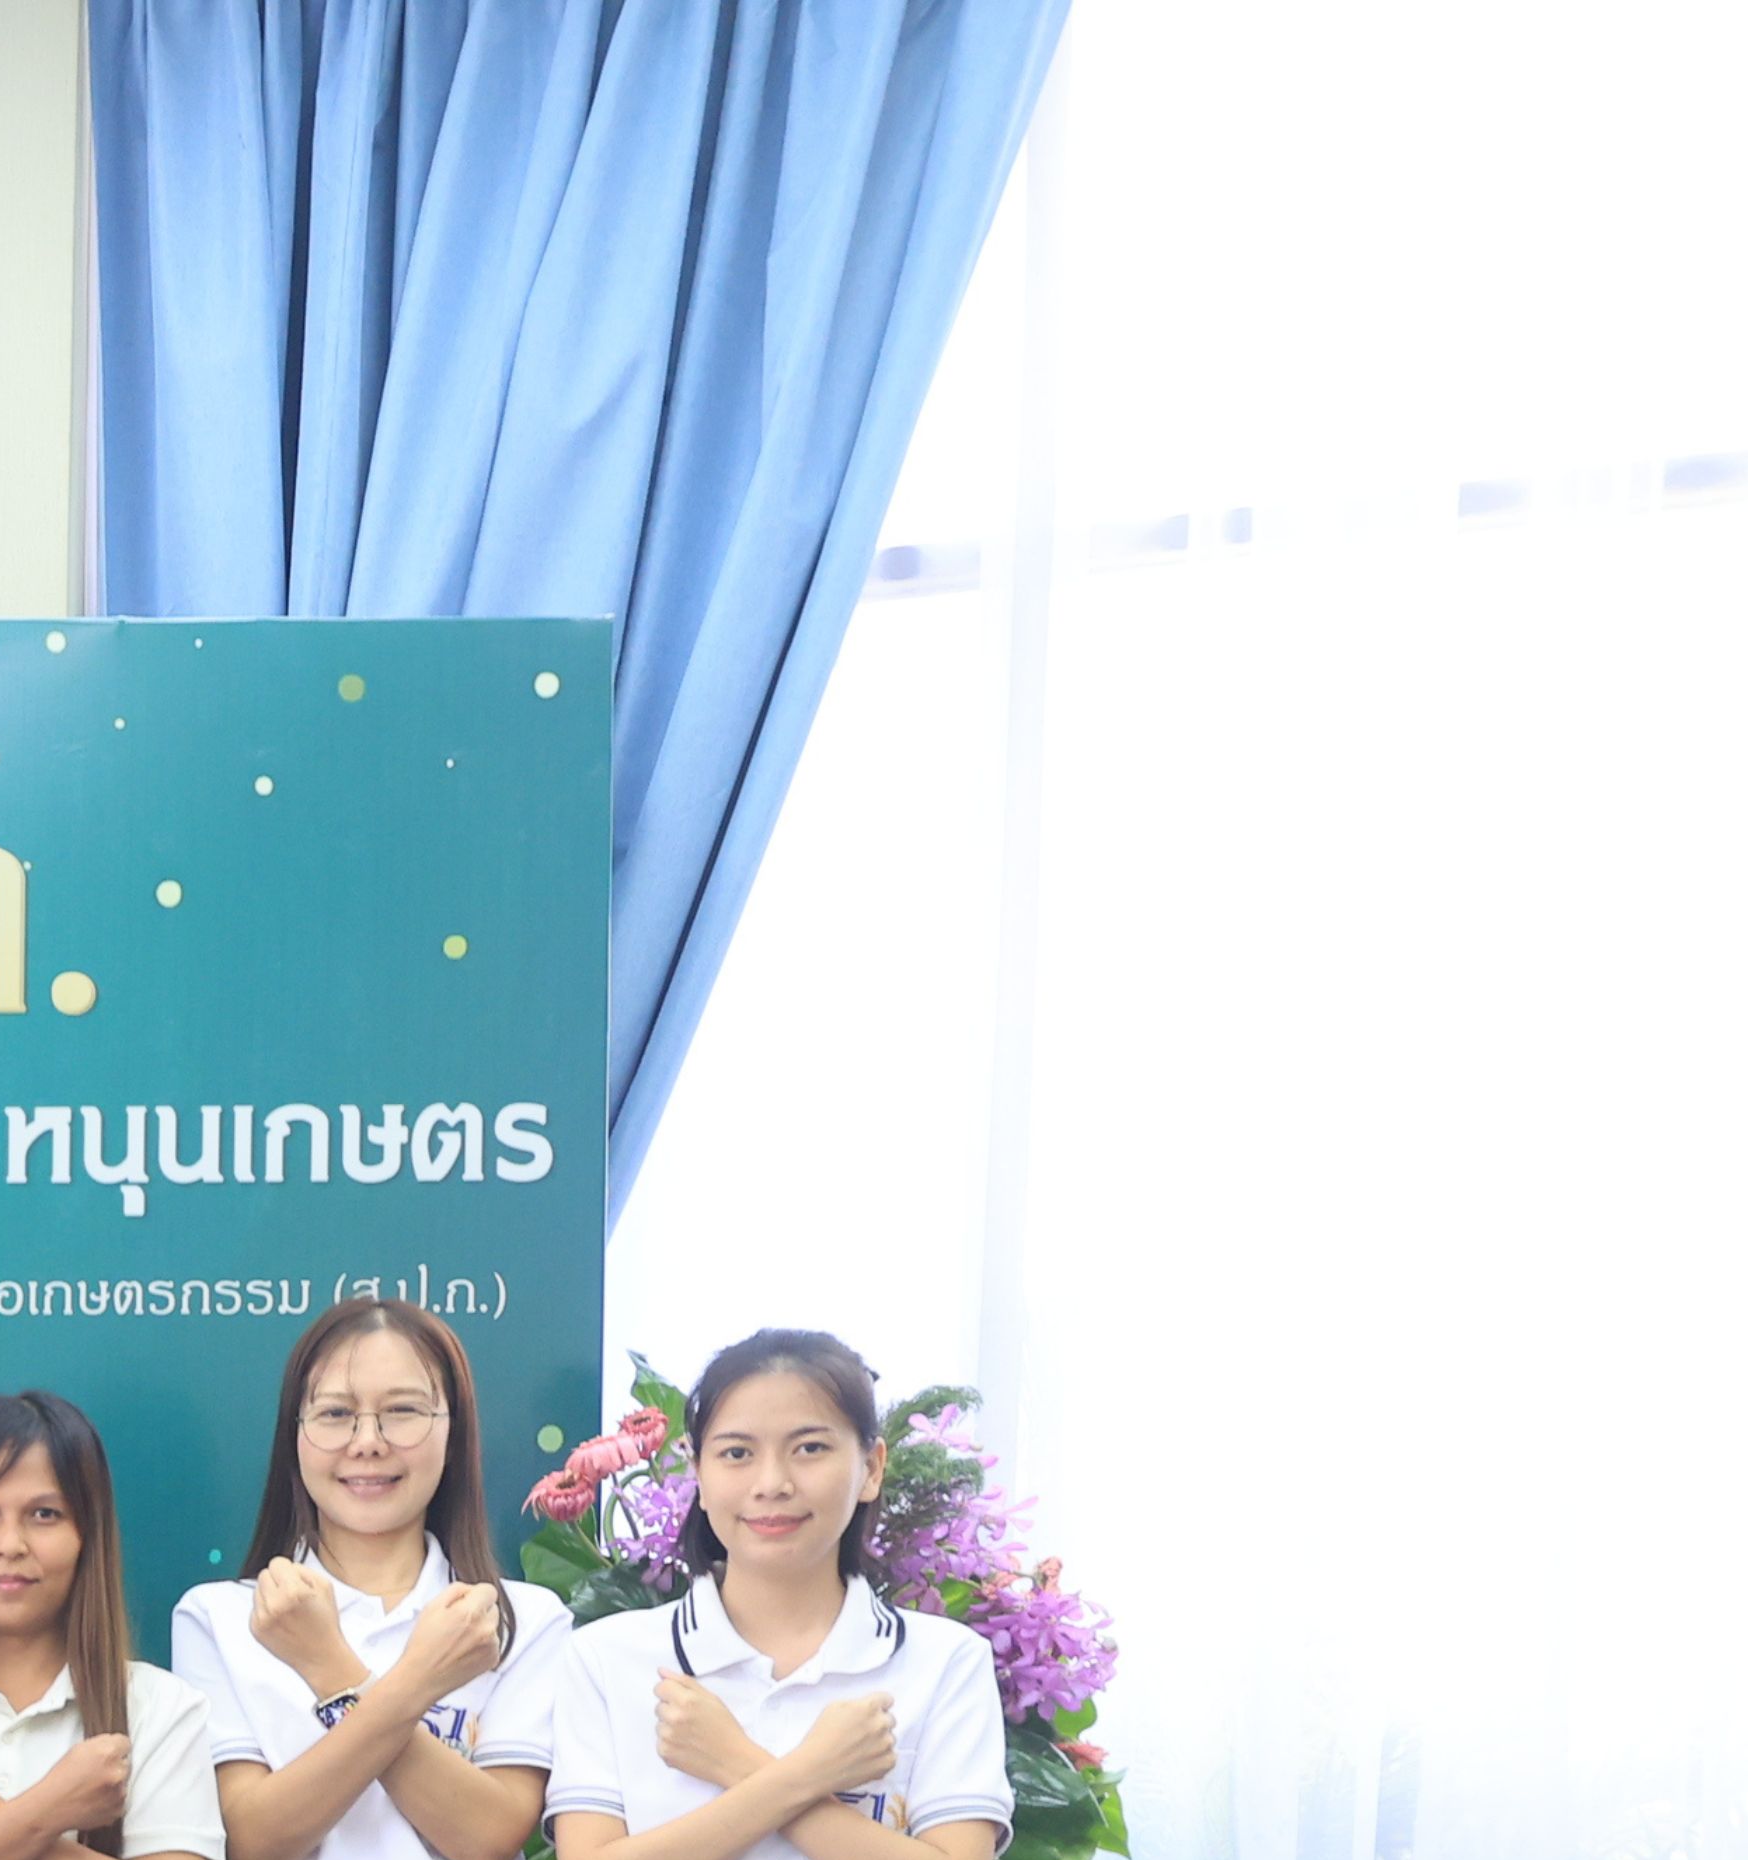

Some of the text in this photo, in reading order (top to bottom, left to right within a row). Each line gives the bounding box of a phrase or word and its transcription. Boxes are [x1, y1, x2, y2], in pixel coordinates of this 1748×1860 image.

[4, 1098, 554, 1217] หนุนเกษตร
[333, 1262, 507, 1321] (สป.ก.)
